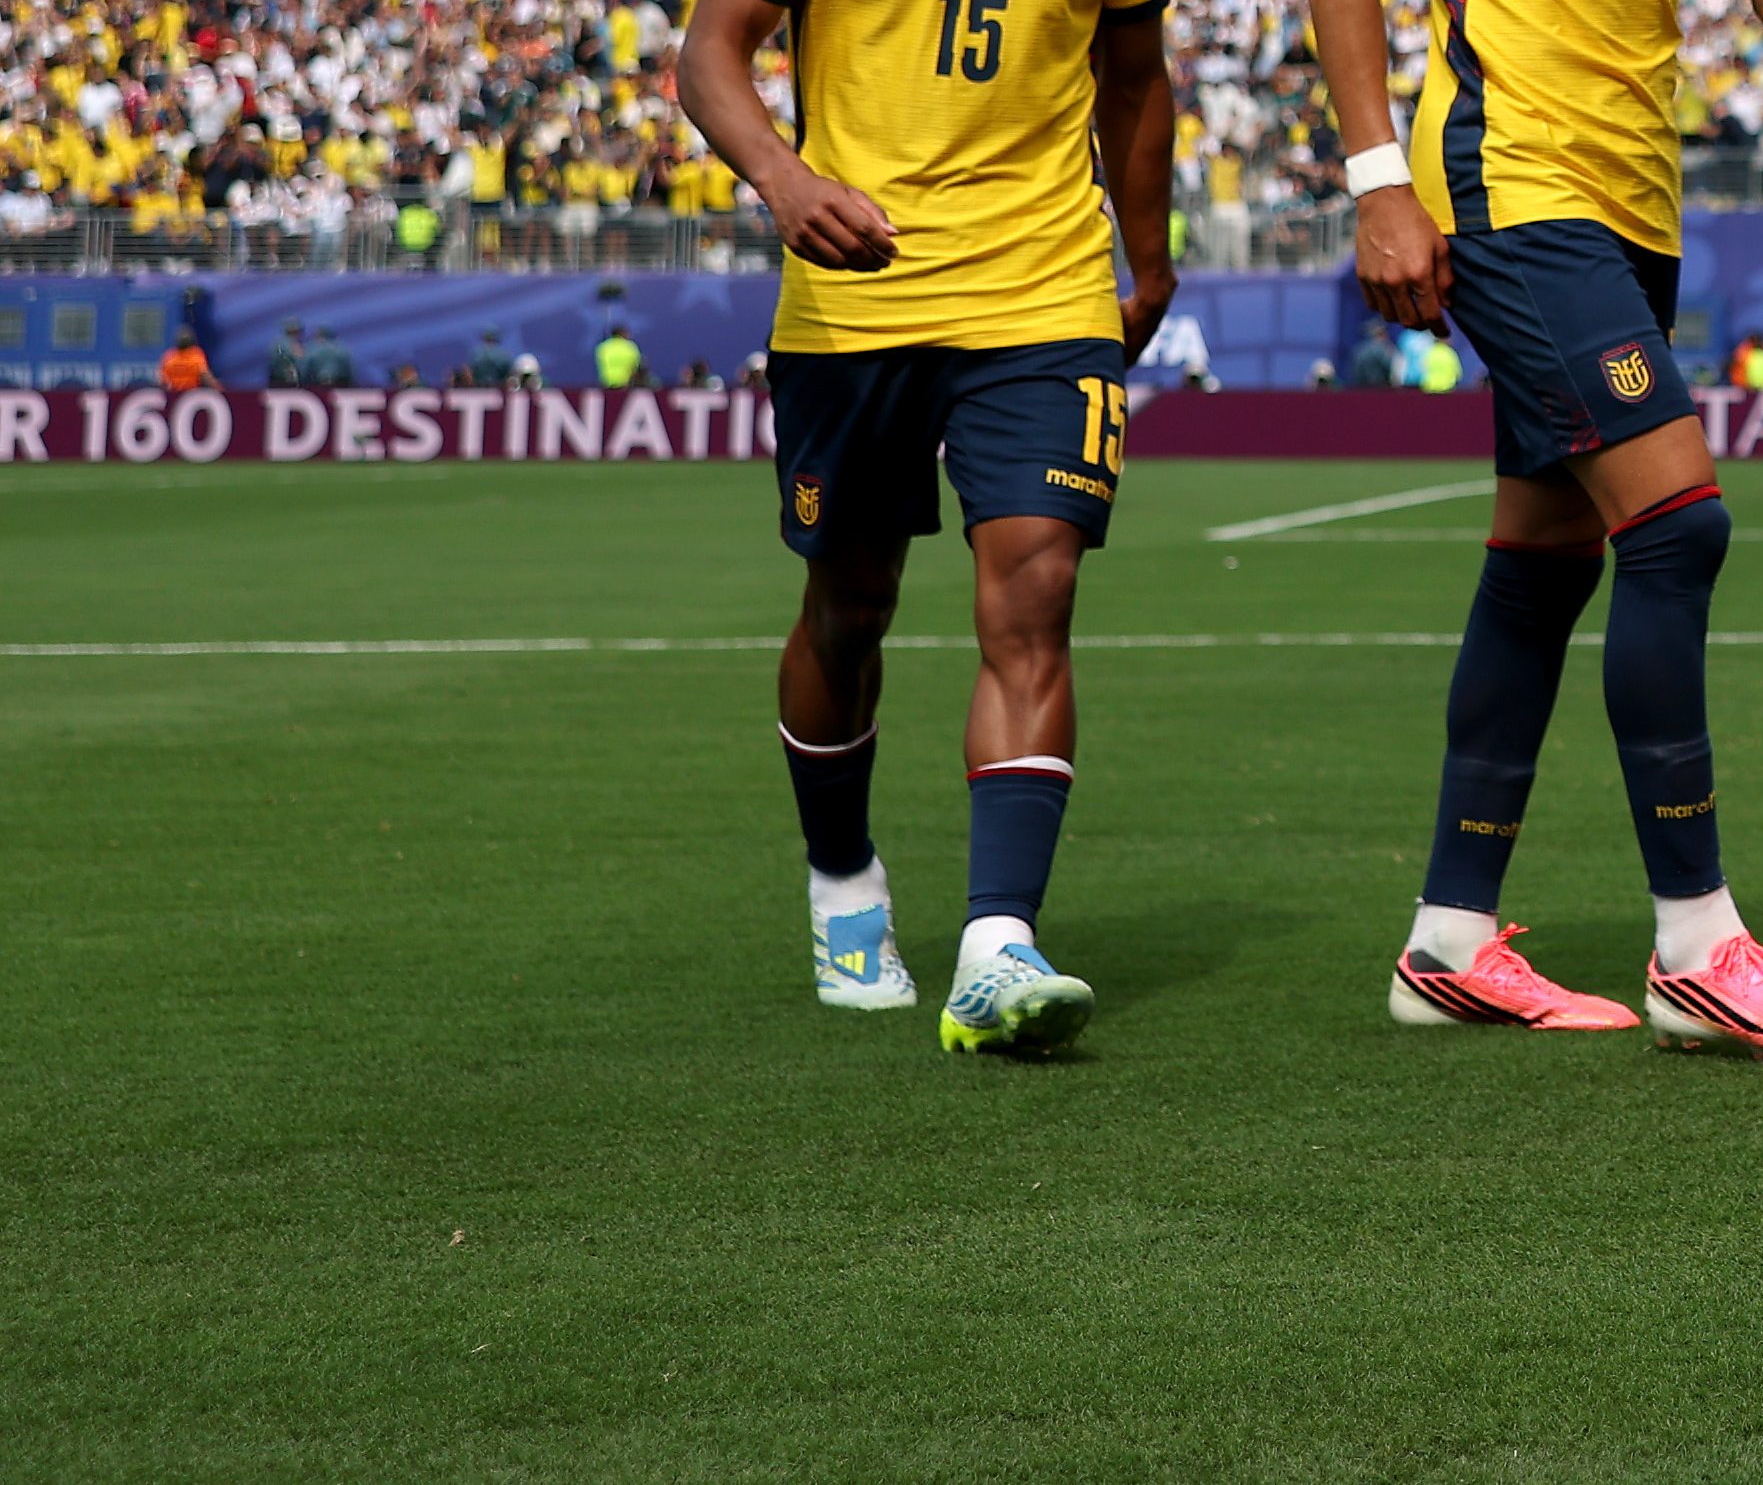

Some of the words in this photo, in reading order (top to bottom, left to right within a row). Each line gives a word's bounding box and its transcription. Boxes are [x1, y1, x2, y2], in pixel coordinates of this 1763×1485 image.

[83, 389, 232, 462] 160
[266, 389, 776, 462] DESTINATI
[1077, 375, 1128, 478] 15
